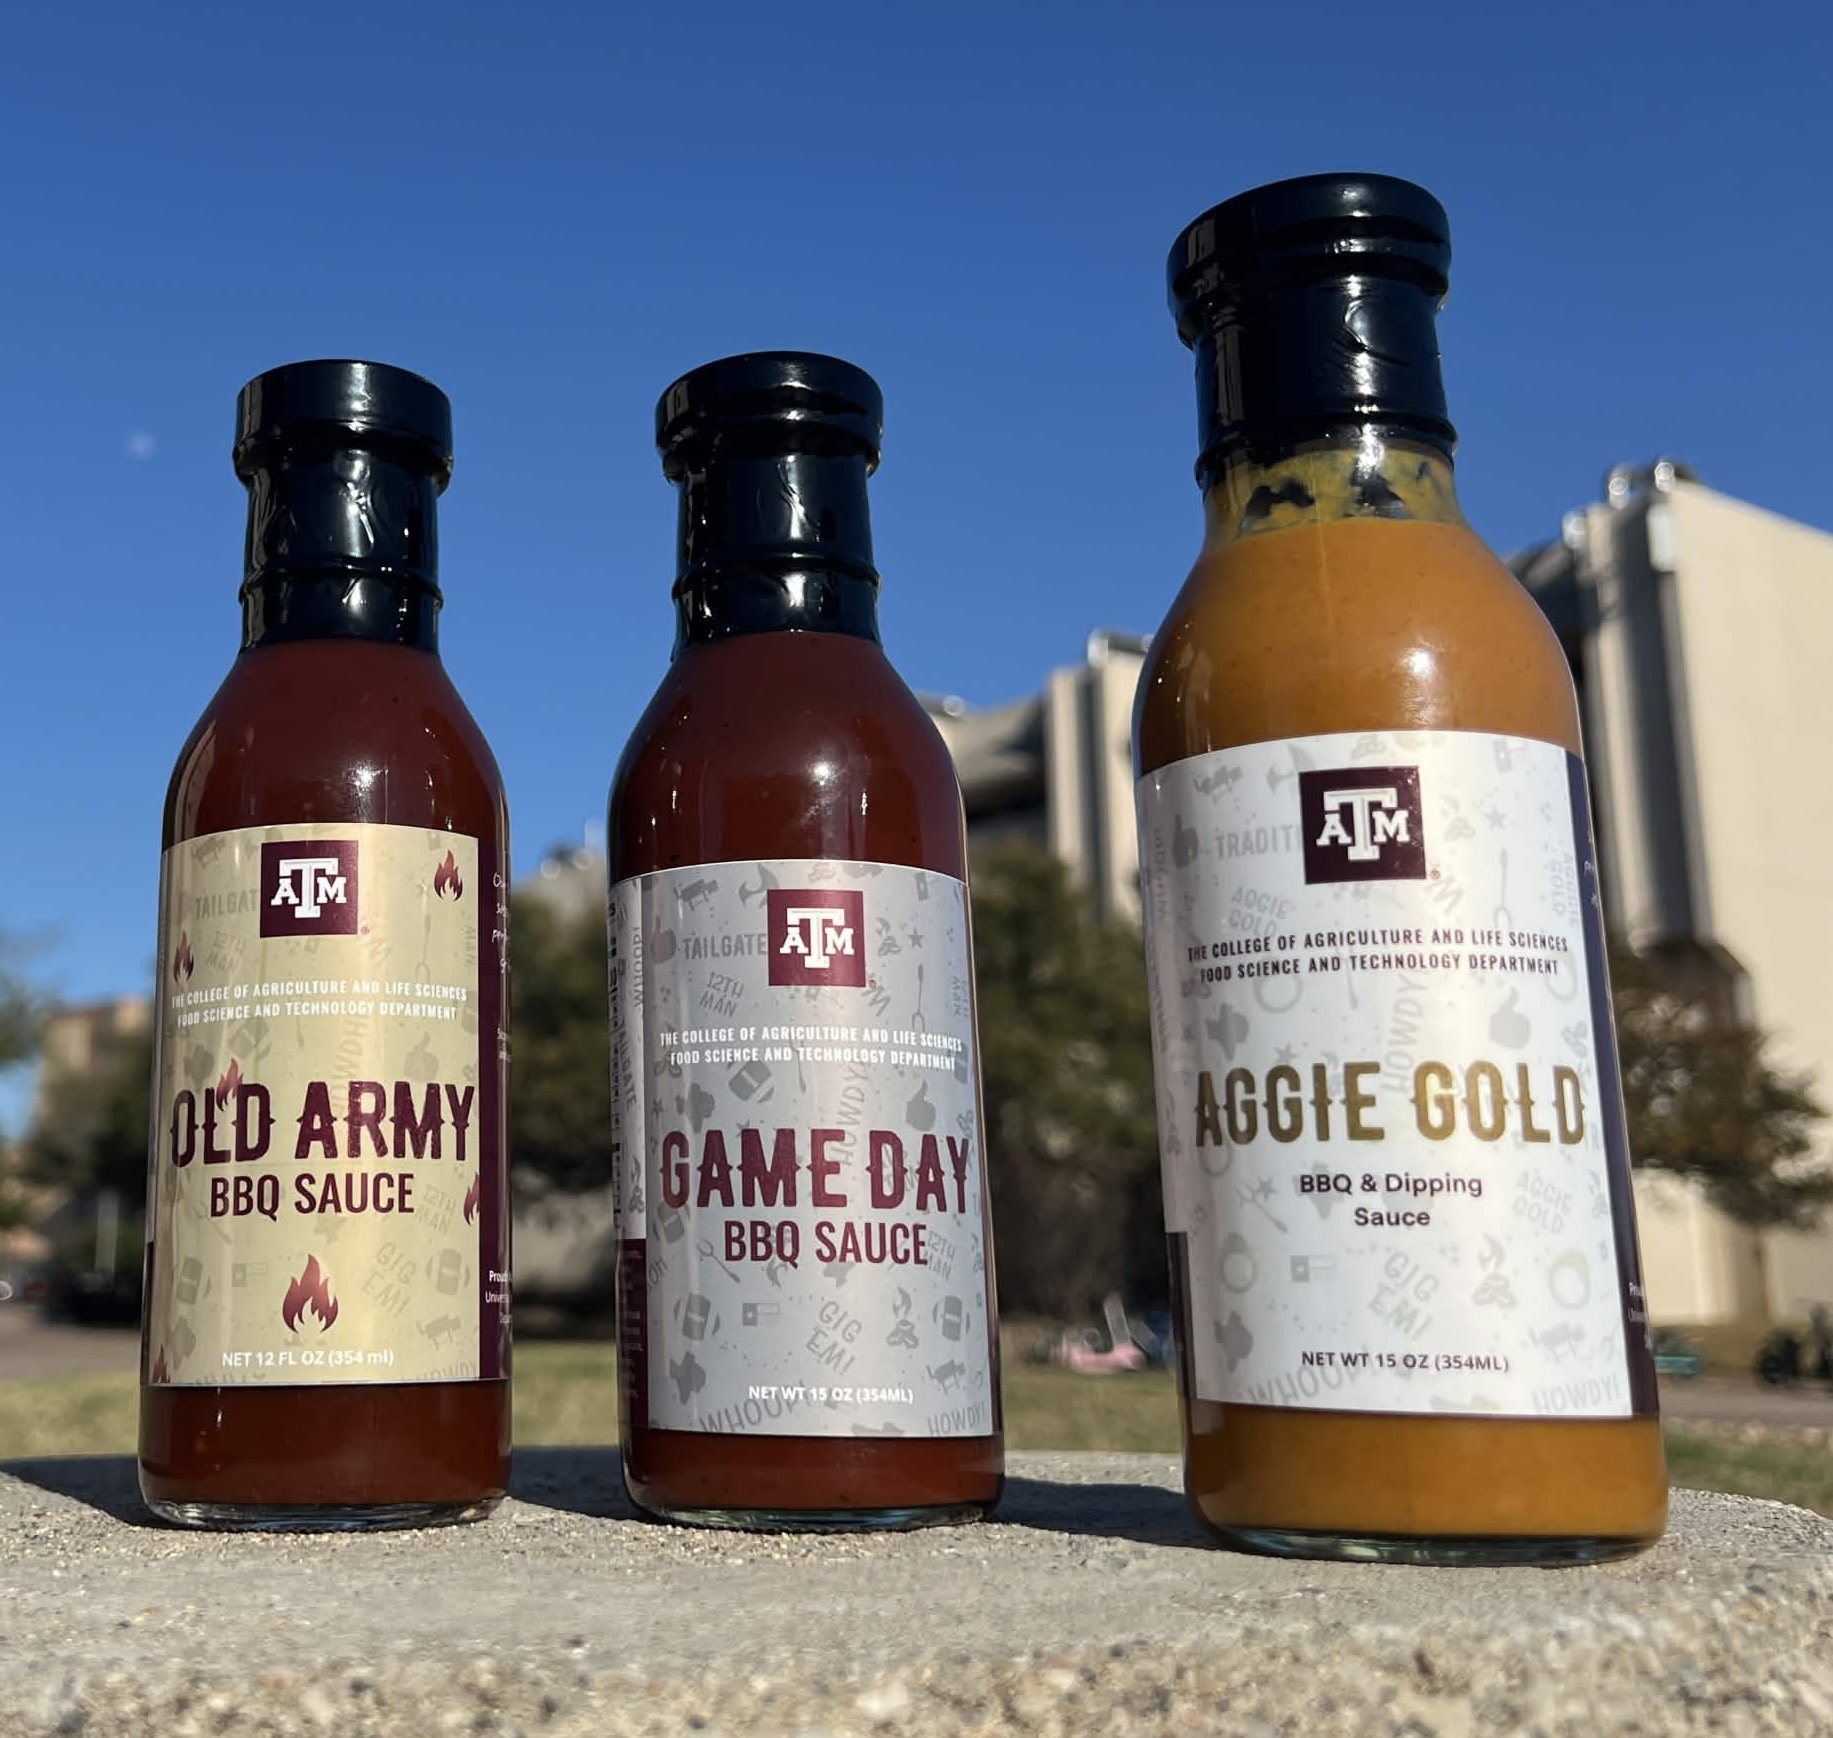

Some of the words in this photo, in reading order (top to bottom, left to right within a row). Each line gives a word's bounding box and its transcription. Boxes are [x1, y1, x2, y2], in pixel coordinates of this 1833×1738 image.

[1188, 946, 1207, 963] THE
[1212, 936, 1271, 959] COLLEGE
[1277, 934, 1297, 951] OF
[1303, 929, 1423, 948] AGRICULTURE
[1431, 930, 1464, 945] AND
[1471, 930, 1502, 946] LIFE
[1508, 932, 1568, 952] SCIENCES
[1200, 965, 1232, 983] FOOD
[1237, 959, 1300, 978] SCIENCE
[1308, 956, 1341, 972] AND
[1350, 953, 1462, 972] TECHNOLOGY
[1468, 955, 1559, 976] DEPARTMENT
[172, 995, 185, 1008] THE
[187, 987, 229, 1006] COLLEGE
[234, 985, 250, 998] OF
[253, 980, 347, 997] AGRICULTURE
[353, 980, 380, 994] AND
[385, 982, 411, 995] LIFE
[415, 983, 467, 1001] SCIENCES
[707, 971, 745, 999] 12TH
[177, 1012, 200, 1028] FOOD
[203, 1006, 251, 1024] SCIENCE
[255, 1003, 280, 1017] AND
[285, 1001, 374, 1017] TECHNOLOGY
[379, 1003, 457, 1020] DEPARTMENT
[700, 994, 738, 1018] MAN
[660, 1032, 678, 1047] THE
[682, 1028, 734, 1044] COLLEGE
[740, 1027, 756, 1041] OF
[762, 1026, 857, 1041] AGRICULTURE
[863, 1029, 888, 1043] AND
[893, 1031, 916, 1045] LIFE
[921, 1034, 962, 1052] SCIENCES
[671, 1051, 699, 1065] FOOD
[704, 1049, 758, 1063] SCIENCE
[764, 1048, 792, 1061] AND
[799, 1049, 885, 1064] TECHNOLOGY
[891, 1051, 956, 1072] DEPARTMENT
[1194, 1061, 1385, 1147] AGGIE
[1411, 1060, 1585, 1145] GOLD
[170, 1083, 276, 1167] OLD
[294, 1081, 475, 1161] ARMY
[660, 1128, 848, 1209] GAME
[866, 1130, 969, 1214] DAY
[1300, 1174, 1353, 1196] BBQ
[1361, 1174, 1378, 1194] &
[1385, 1172, 1483, 1198] Dipping
[210, 1175, 280, 1222] BBQ
[294, 1172, 415, 1214] SAUCE
[1354, 1207, 1431, 1227] Sauce
[724, 1220, 800, 1269] BBQ
[815, 1221, 928, 1265] SAUCE
[377, 1241, 417, 1284] GIG
[1385, 1252, 1438, 1301] GIG
[819, 1300, 863, 1344] GIG
[222, 1353, 251, 1367] NET
[256, 1352, 275, 1367] 12
[279, 1352, 298, 1366] FL
[302, 1352, 325, 1366] OZ
[329, 1351, 364, 1367] (354
[368, 1350, 395, 1366] ml)
[1301, 1351, 1336, 1367] NET
[1340, 1352, 1369, 1368] WT
[1375, 1353, 1396, 1368] 15
[1402, 1353, 1429, 1370] OZ
[1434, 1353, 1510, 1372] (354ML)
[748, 1386, 776, 1400] NET
[781, 1386, 805, 1400] WT
[809, 1387, 827, 1401] 15
[831, 1387, 853, 1401] OZ
[856, 1388, 914, 1404] (354ML)
